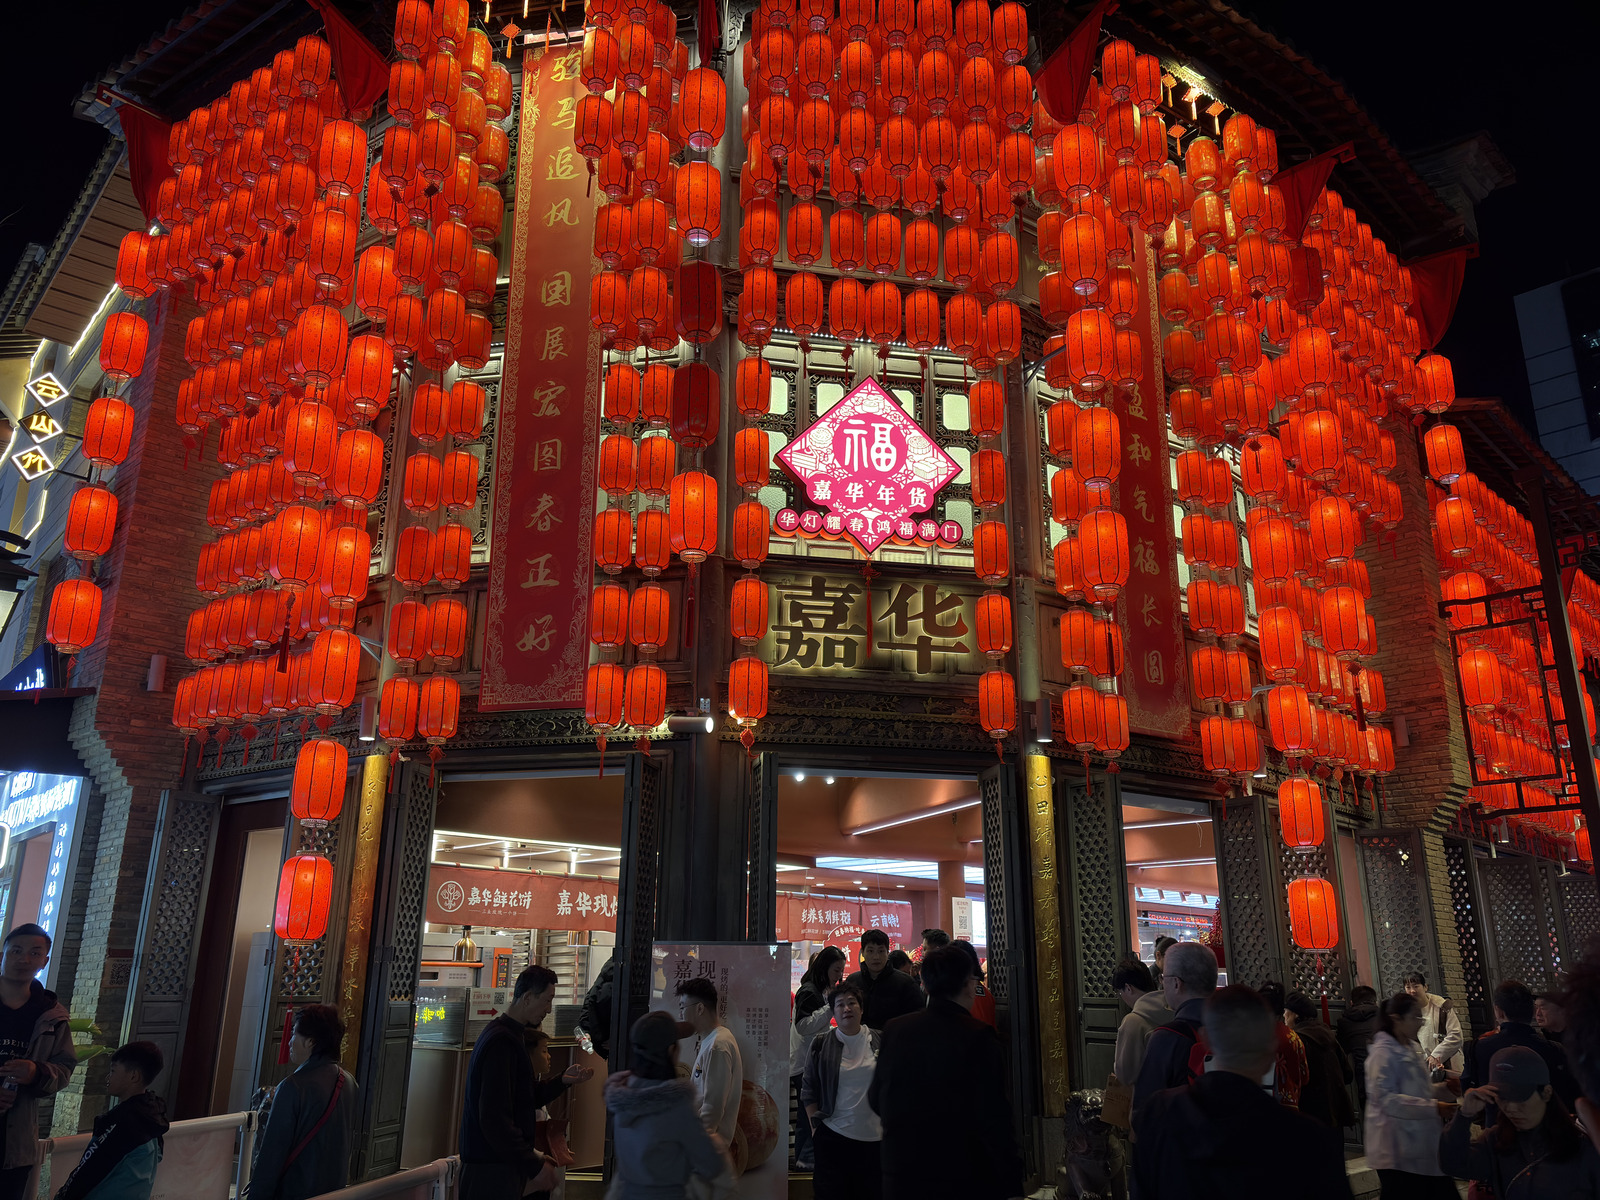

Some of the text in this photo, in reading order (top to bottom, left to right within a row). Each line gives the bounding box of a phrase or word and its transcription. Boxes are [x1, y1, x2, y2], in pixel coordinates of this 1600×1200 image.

[843, 419, 898, 472] 福
[813, 479, 928, 508] 嘉华年货
[771, 576, 970, 674] 嘉华
[467, 887, 533, 910] 嘉华鲜花饼
[97, 1123, 117, 1145] THE
